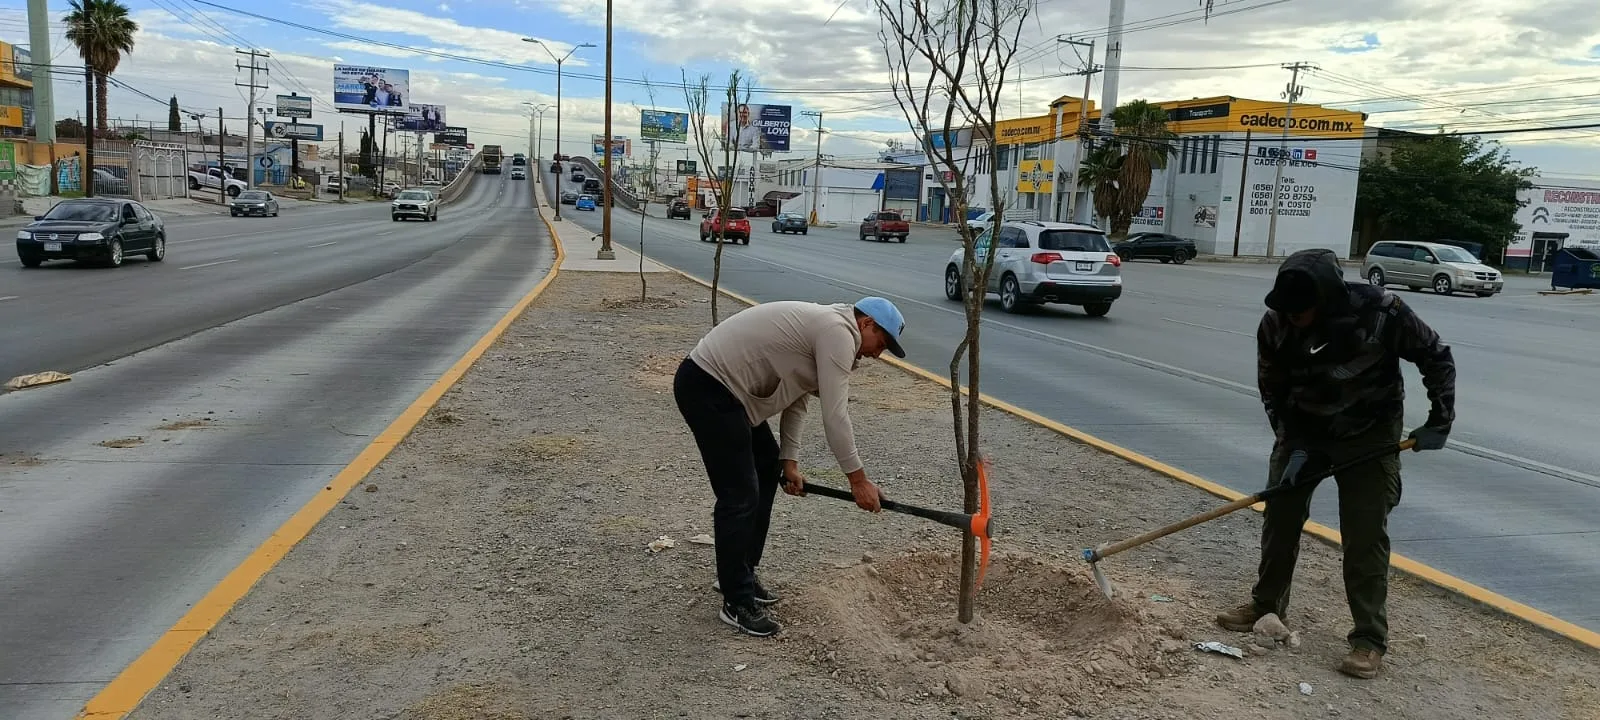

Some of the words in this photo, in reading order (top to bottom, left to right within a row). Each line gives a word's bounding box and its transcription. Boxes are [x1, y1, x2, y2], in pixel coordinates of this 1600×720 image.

[752, 119, 790, 128] GILBERTO
[1240, 112, 1353, 132] cadeco.com.mx
[767, 127, 789, 135] LOYA
[1279, 184, 1291, 192] 70
[1293, 185, 1315, 193] 0170
